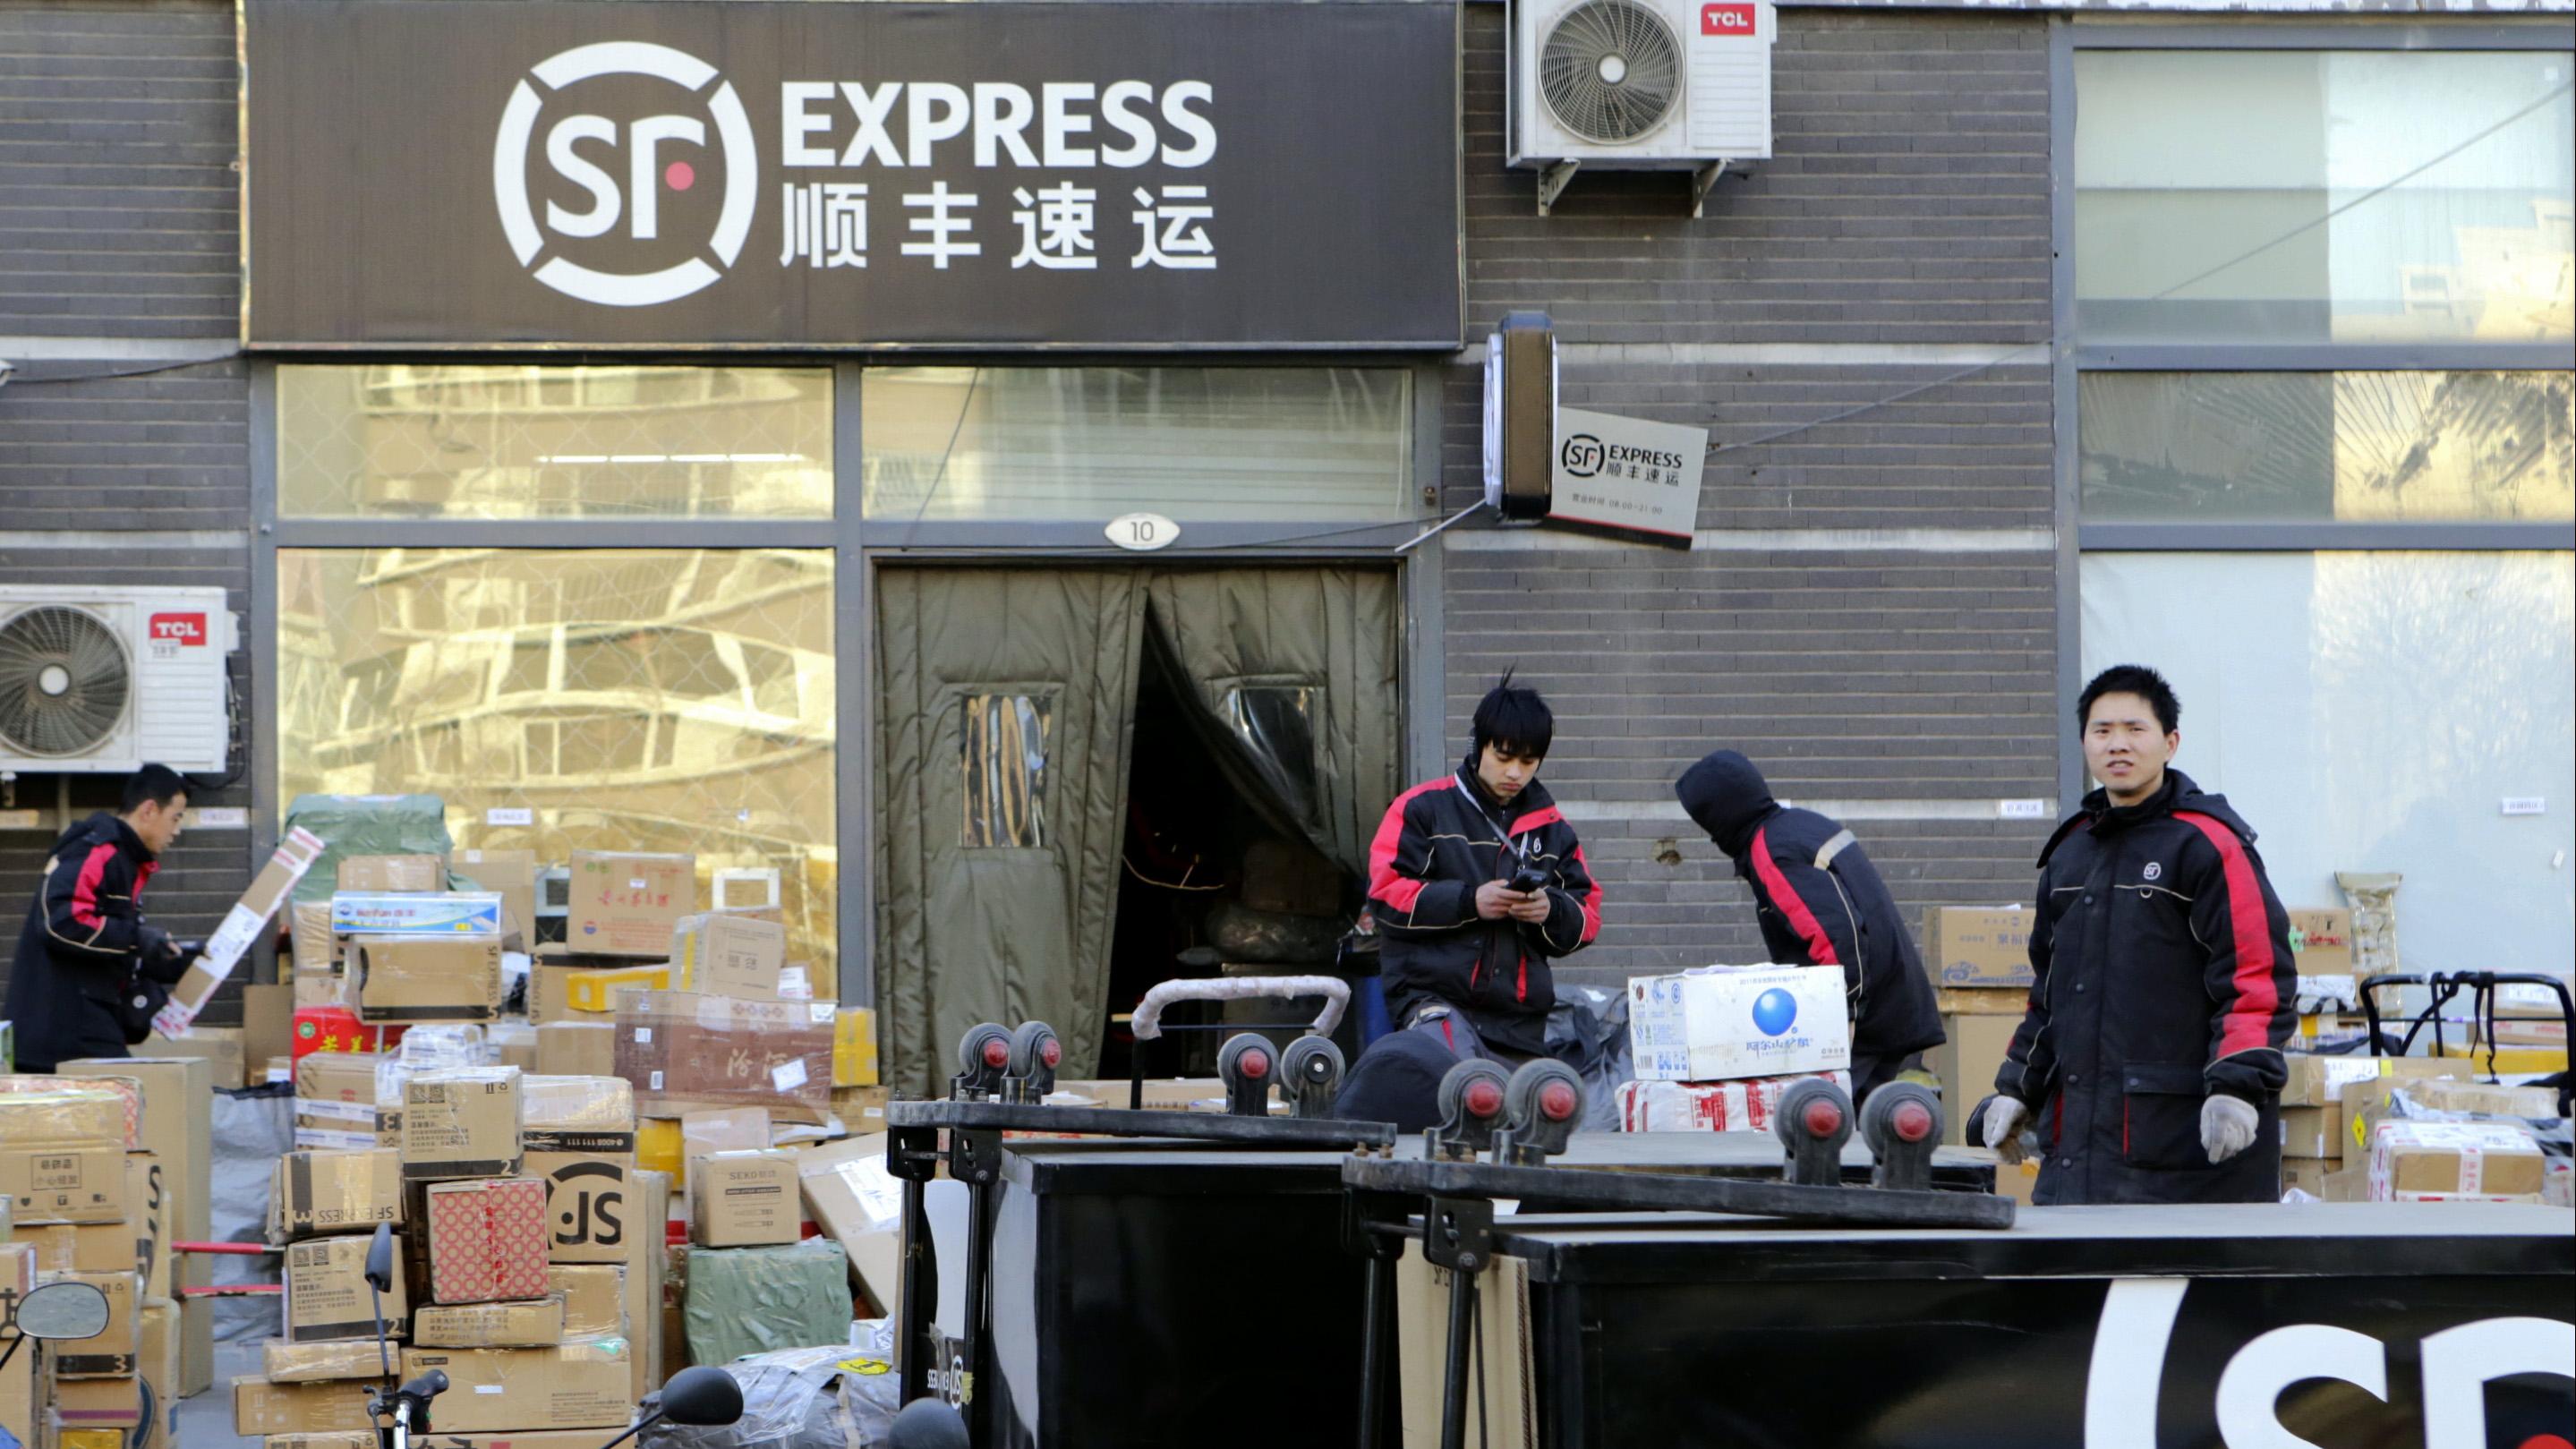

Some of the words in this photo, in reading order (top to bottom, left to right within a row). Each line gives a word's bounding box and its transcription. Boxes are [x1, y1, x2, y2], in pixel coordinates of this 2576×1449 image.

[1709, 12, 1748, 27] TCL
[780, 80, 1217, 168] EXPRESS
[546, 115, 705, 239] SF
[780, 182, 1217, 269] 顺丰速运
[1569, 445, 1598, 467] SF
[1609, 444, 1683, 469] EXPRESS
[1606, 462, 1680, 487] 顺丰速运
[1130, 521, 1154, 541] 10
[157, 621, 200, 637] TCL
